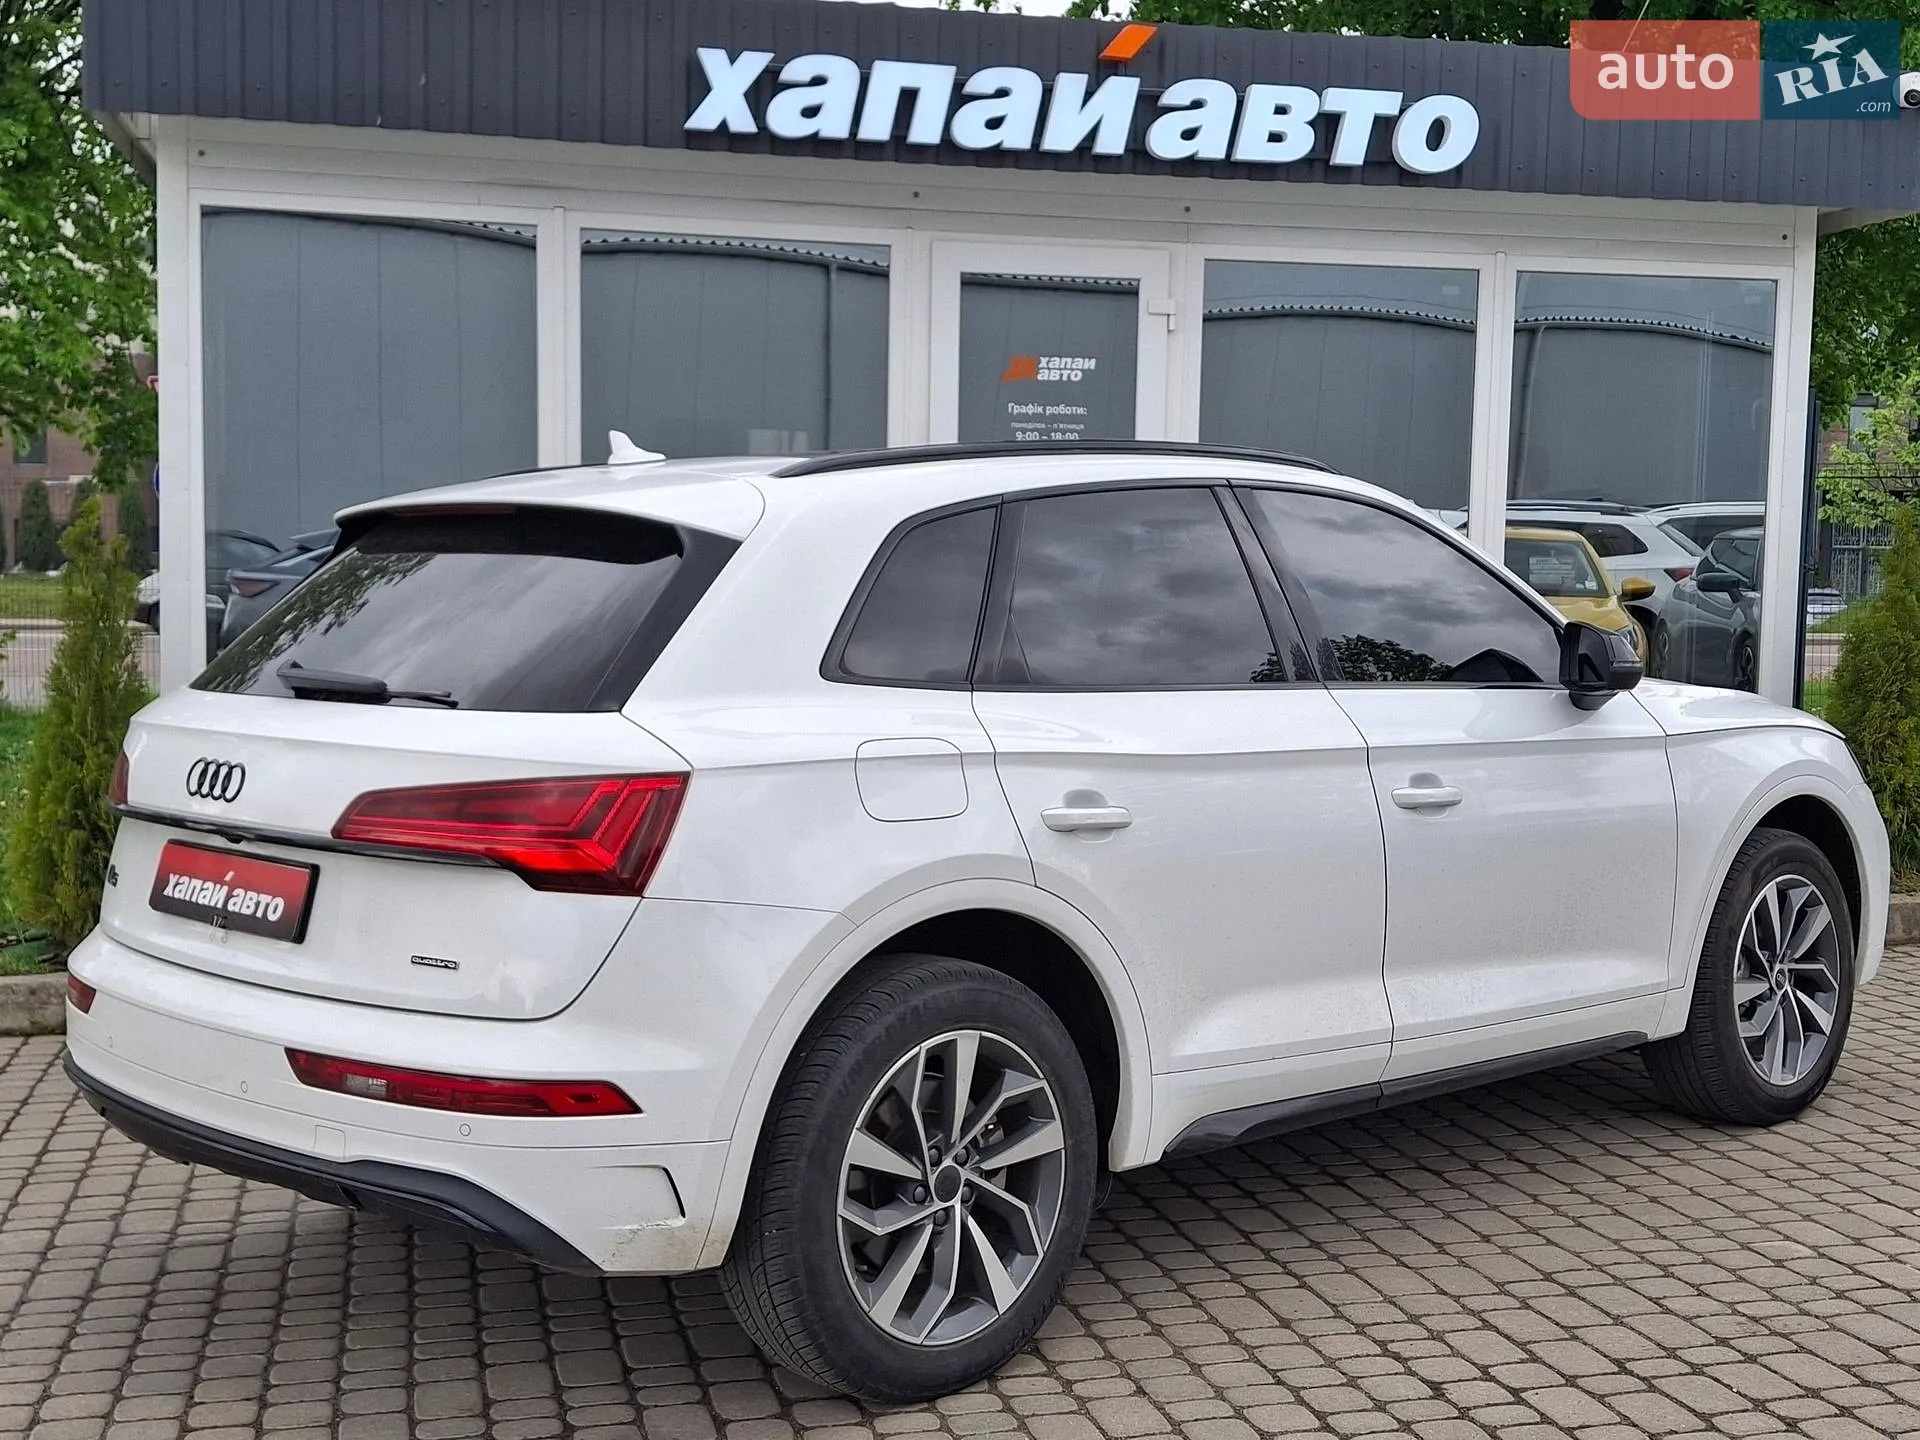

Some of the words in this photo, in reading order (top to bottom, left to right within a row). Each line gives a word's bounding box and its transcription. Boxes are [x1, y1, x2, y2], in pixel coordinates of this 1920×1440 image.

[1144, 76, 1481, 175] авто
[1037, 369, 1083, 382] авто
[1008, 402, 1043, 416] Графік
[1045, 404, 1088, 416] роботи:
[227, 887, 285, 922] авто
[411, 956, 458, 969] quattro
